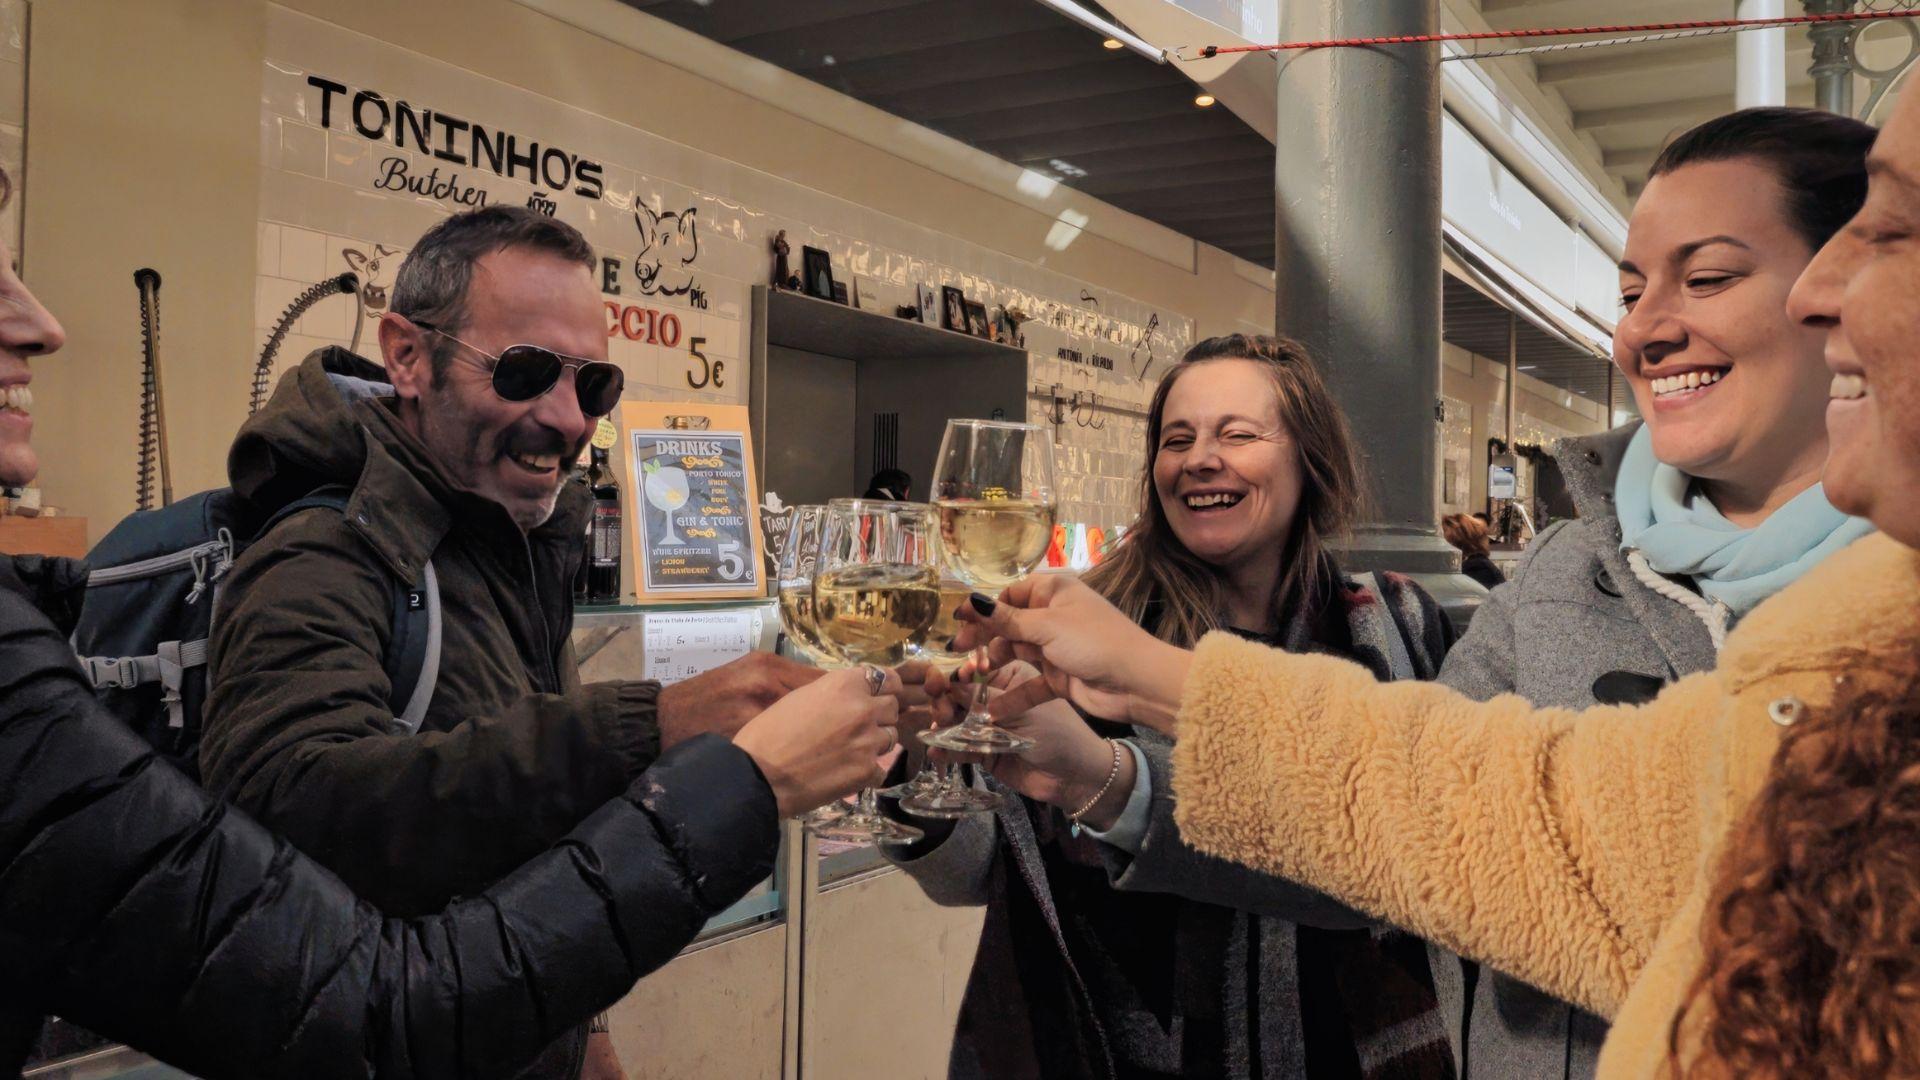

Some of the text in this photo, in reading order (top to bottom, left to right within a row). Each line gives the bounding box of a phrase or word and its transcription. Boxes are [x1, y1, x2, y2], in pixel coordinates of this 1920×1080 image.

[307, 75, 603, 200] TONINHO'S
[374, 157, 488, 208] Butcher
[655, 440, 723, 456] DRINKS
[676, 516, 744, 527] GIN & TONIC
